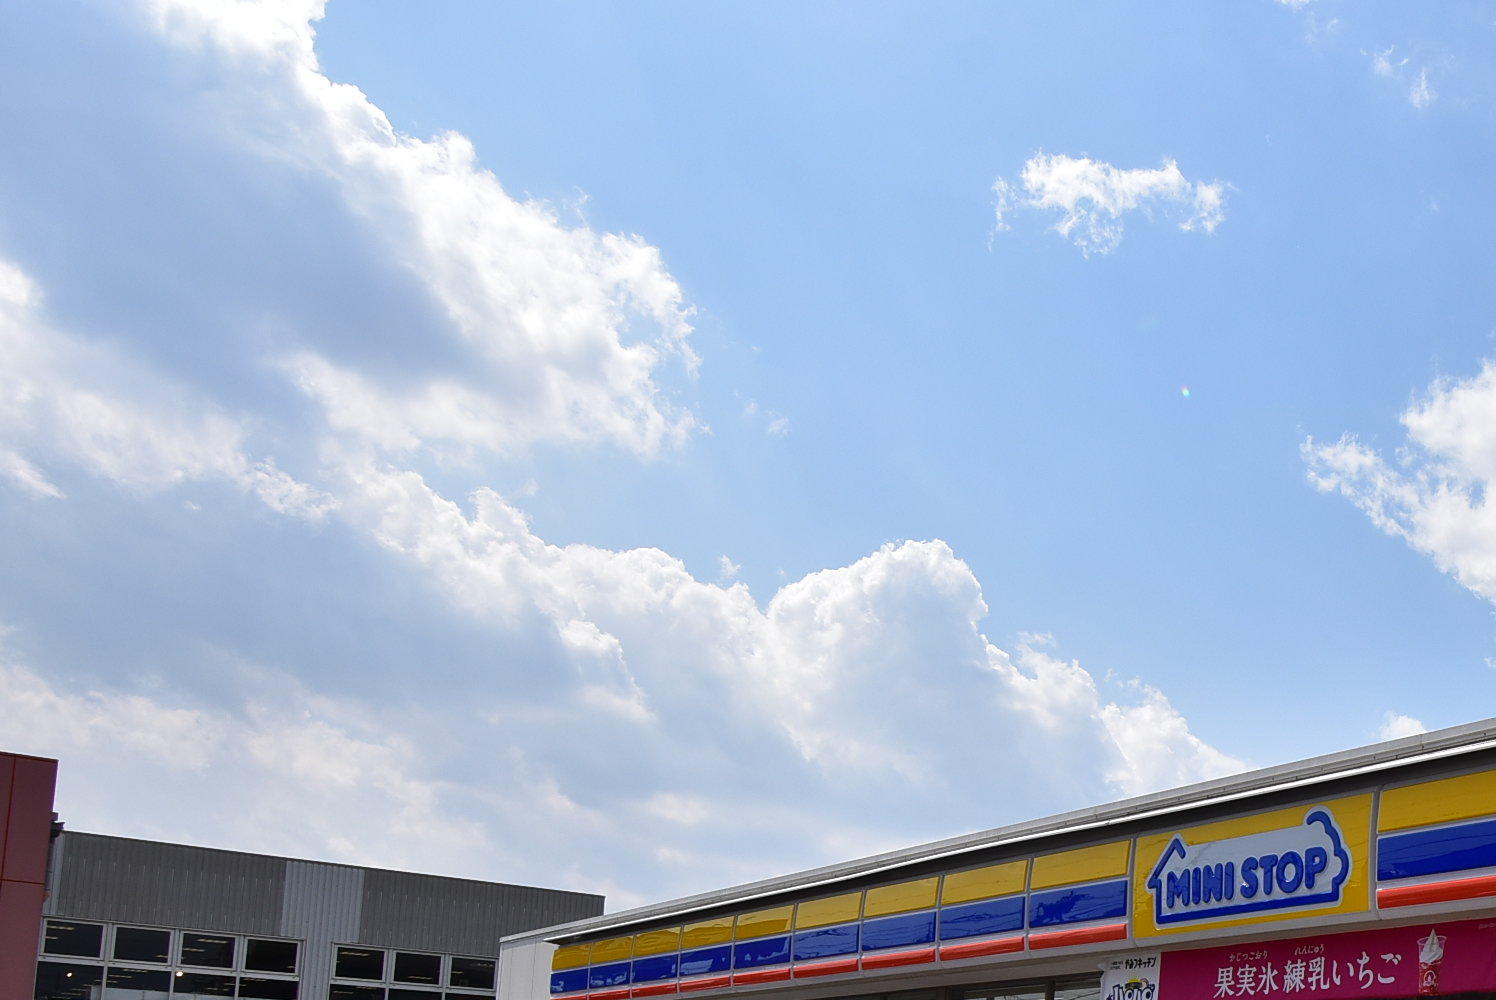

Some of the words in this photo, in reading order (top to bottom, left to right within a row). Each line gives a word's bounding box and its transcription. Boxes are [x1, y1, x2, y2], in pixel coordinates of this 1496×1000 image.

[1166, 860, 1234, 909] MINI
[1241, 846, 1329, 899] STOP
[1229, 950, 1269, 963] かじつこおり
